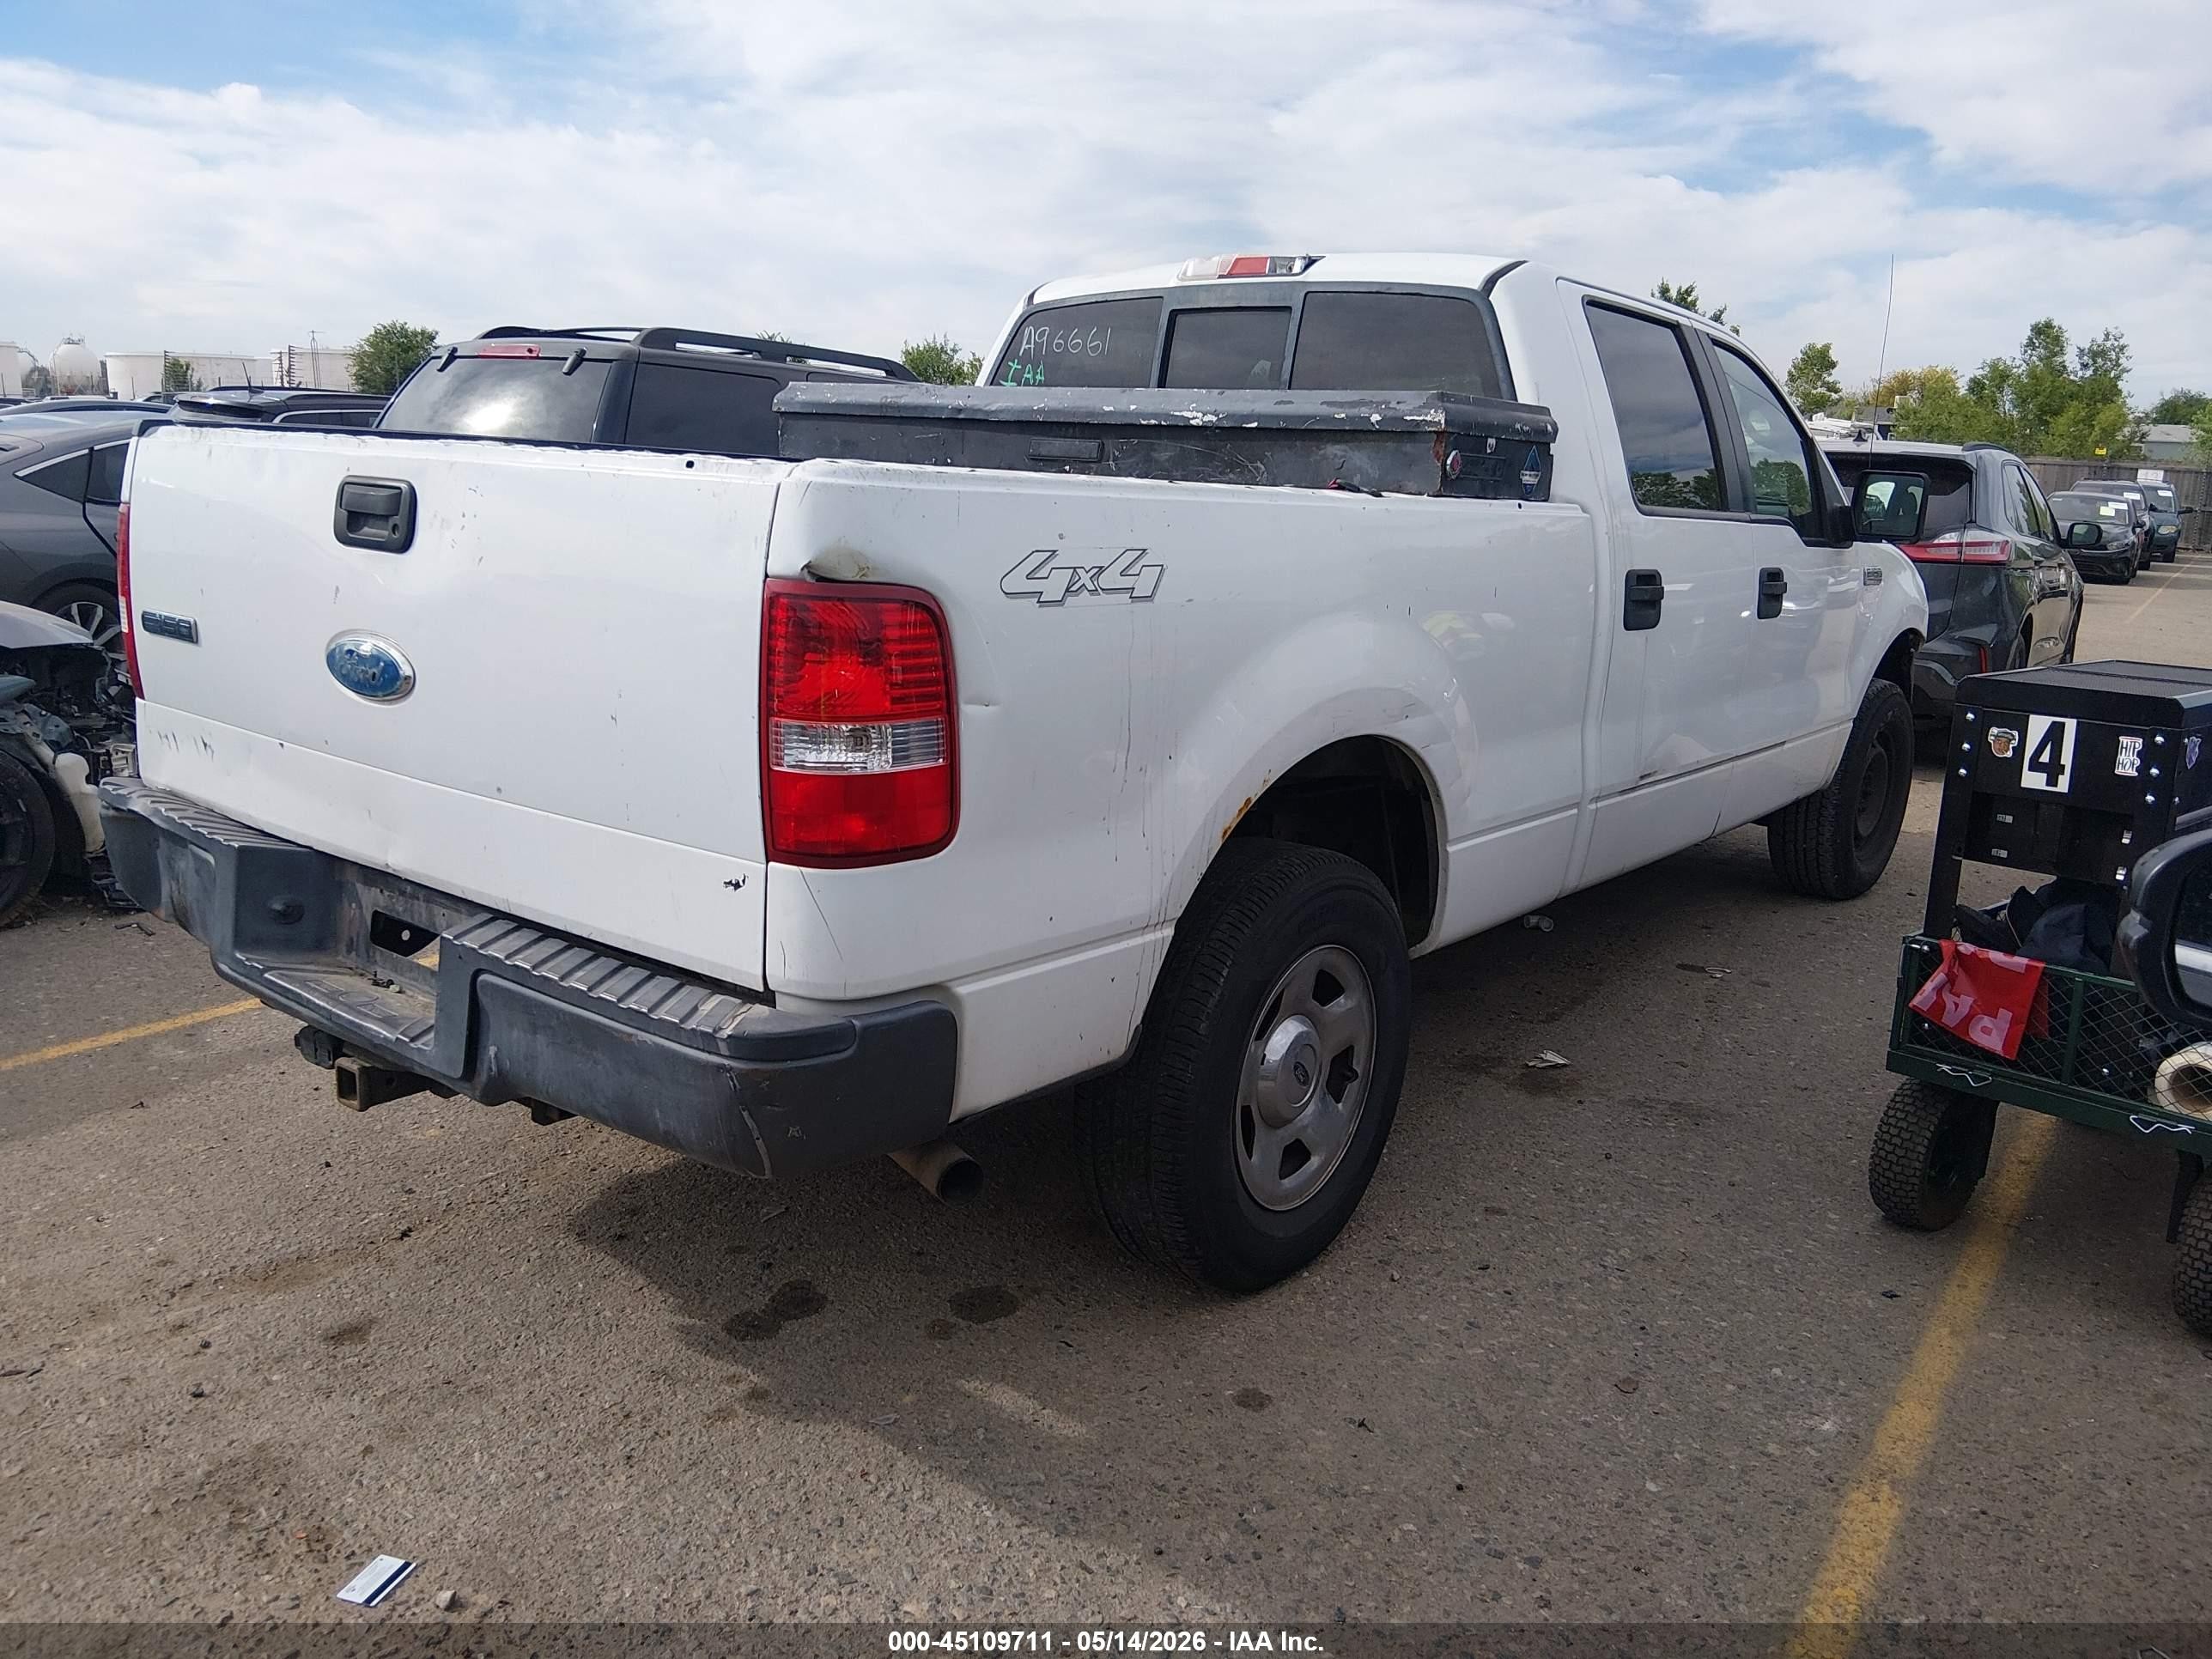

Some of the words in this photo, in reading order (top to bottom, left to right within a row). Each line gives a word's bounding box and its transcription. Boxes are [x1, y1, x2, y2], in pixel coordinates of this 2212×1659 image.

[1019, 325, 1111, 360] A96661
[1000, 359, 1045, 386] IAA
[1000, 548, 1166, 608] 4x4
[2027, 720, 2066, 788] 4
[2119, 738, 2142, 758] HIP
[2117, 757, 2141, 773] HOP
